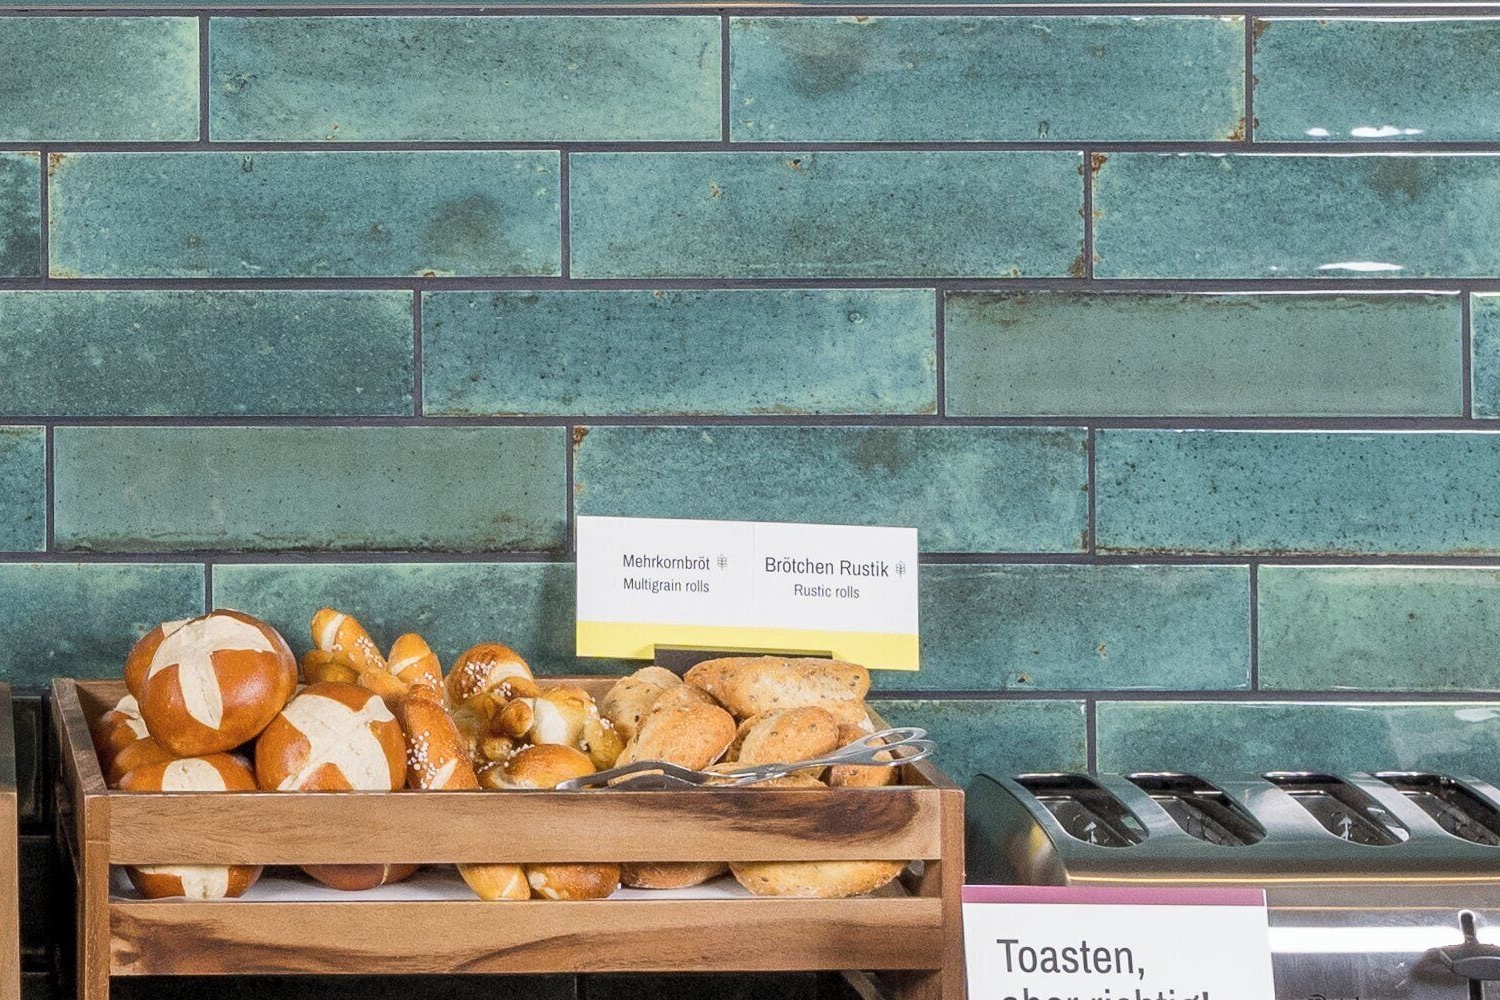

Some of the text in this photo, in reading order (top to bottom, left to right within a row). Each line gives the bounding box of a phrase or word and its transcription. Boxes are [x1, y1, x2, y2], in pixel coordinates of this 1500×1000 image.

[622, 553, 710, 571] Mehrkornbröt
[765, 556, 889, 578] Brötchen Rustik
[623, 577, 710, 594] Multigrain rolls
[794, 583, 860, 599] Rustic rolls
[996, 938, 1145, 981] Toasten,
